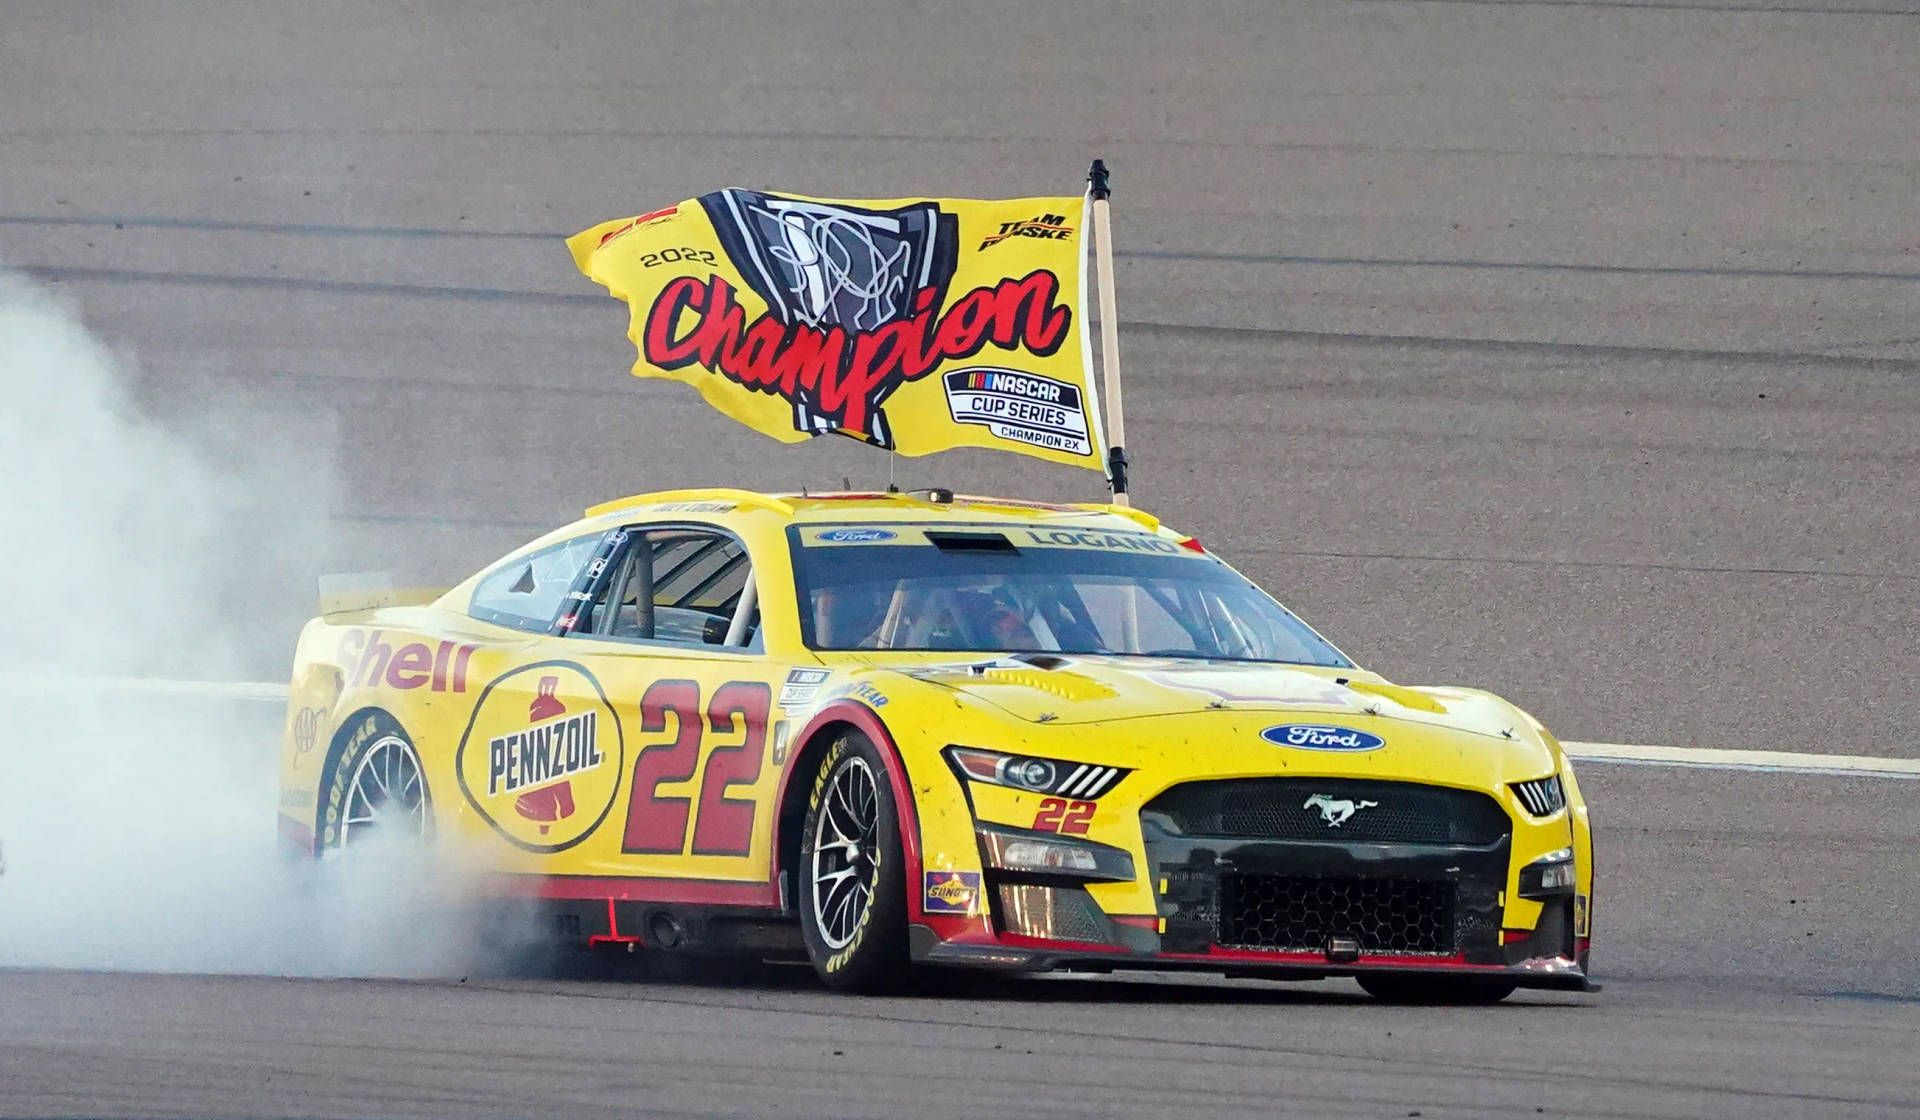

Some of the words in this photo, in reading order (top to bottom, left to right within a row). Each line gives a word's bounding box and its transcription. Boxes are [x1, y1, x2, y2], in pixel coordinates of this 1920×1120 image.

[640, 247, 718, 268] 2022
[643, 269, 1072, 432] Champion
[991, 373, 1061, 402] NASCAR
[971, 397, 1006, 413] CUP
[1007, 402, 1067, 426] SERIES
[1001, 426, 1062, 447] CHAMPION
[1064, 439, 1080, 450] 2X
[1026, 531, 1179, 553] LOGANO
[337, 629, 478, 693] Shell
[1287, 726, 1361, 747] Ford
[488, 713, 601, 796] PENNZOIL
[621, 679, 772, 858] 22
[810, 740, 841, 812] EAGLE
[1032, 798, 1097, 834] 22
[931, 886, 975, 899] SUNO
